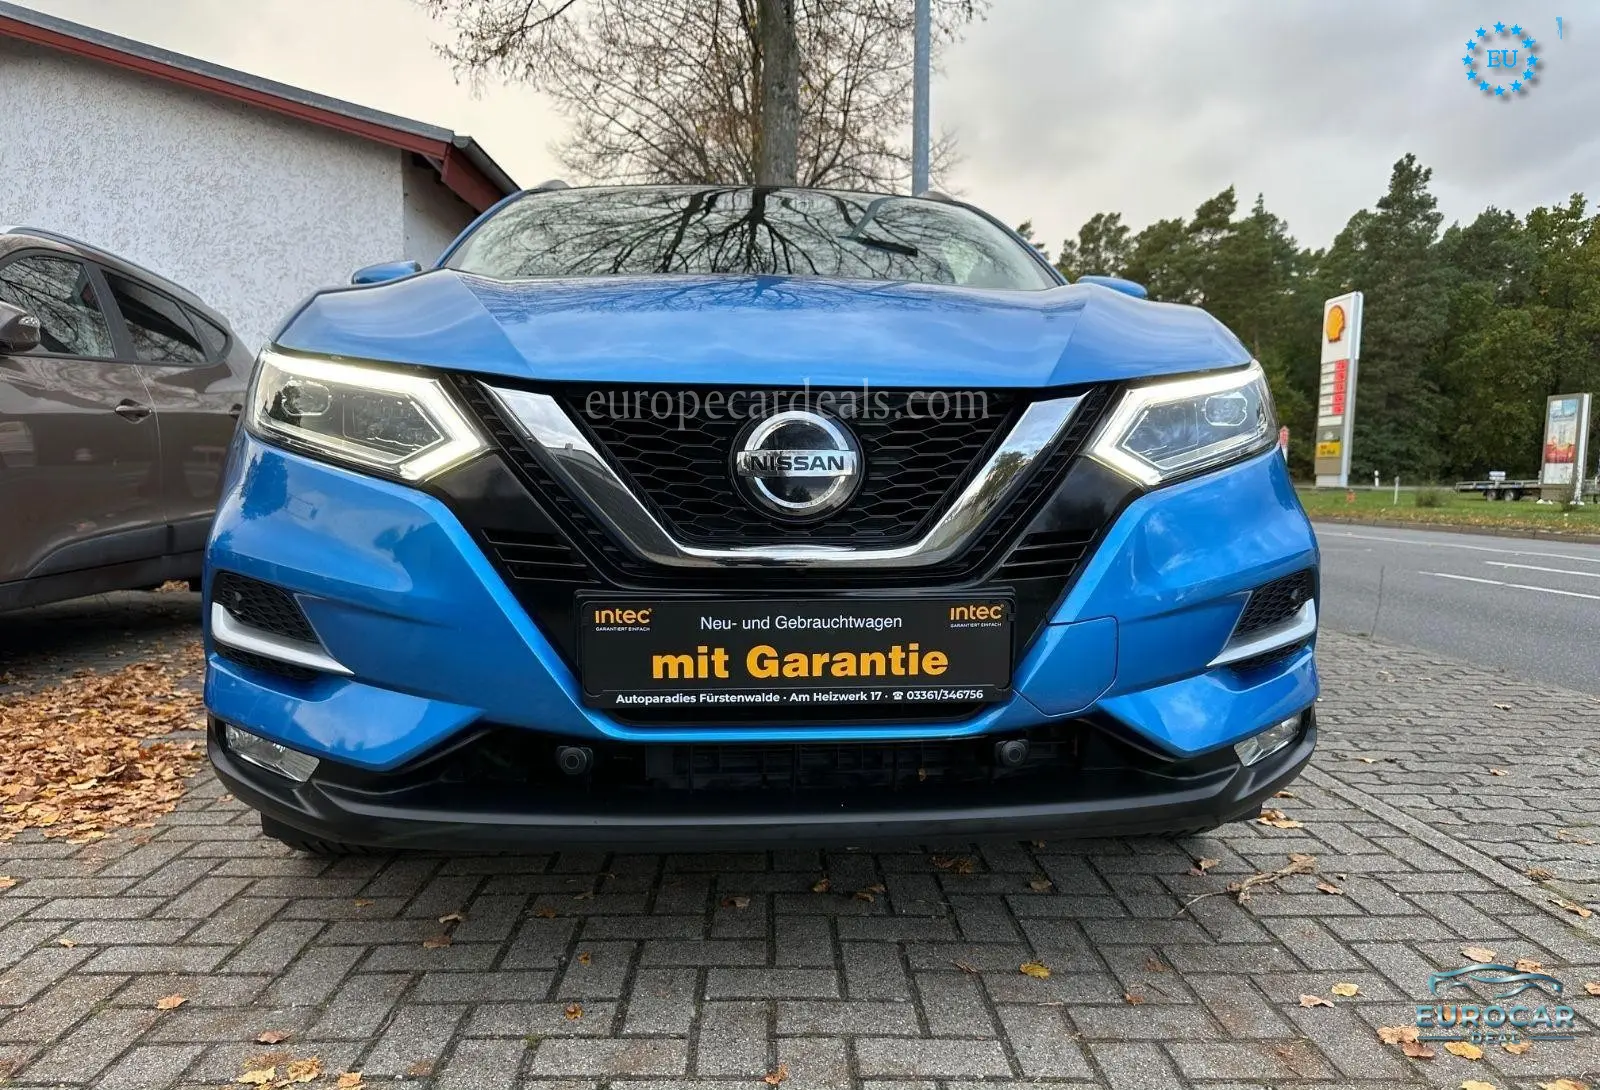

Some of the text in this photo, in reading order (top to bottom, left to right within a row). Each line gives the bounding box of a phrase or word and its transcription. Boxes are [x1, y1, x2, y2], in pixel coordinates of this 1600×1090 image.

[750, 455, 845, 471] NISSAN
[700, 615, 902, 631] Neu- und Gebrauchtwagen
[652, 643, 949, 679] mit Garantie
[616, 689, 984, 705] Autoparadies Fürstenwalde Am Heizwerk 17 03361/346756
